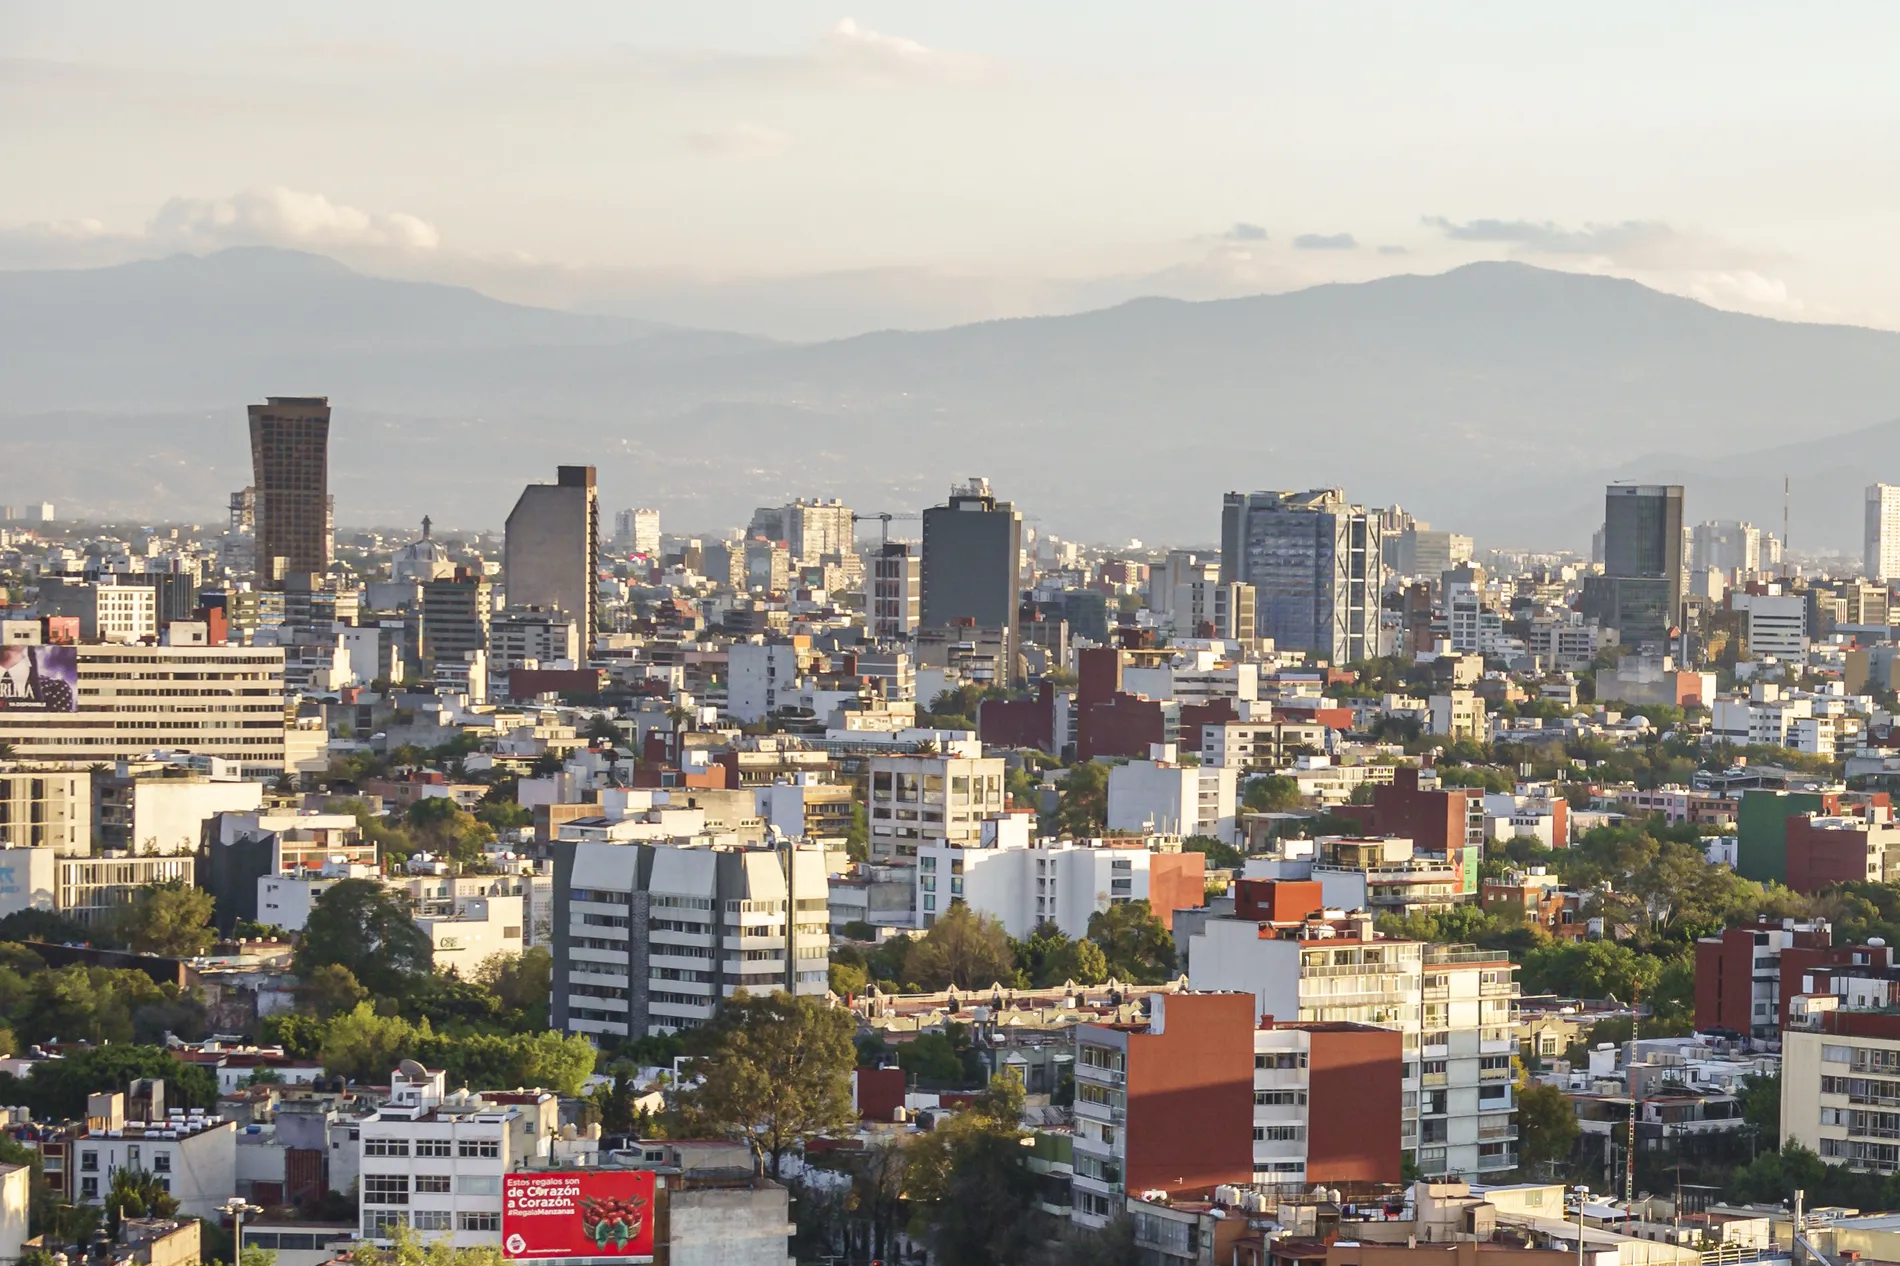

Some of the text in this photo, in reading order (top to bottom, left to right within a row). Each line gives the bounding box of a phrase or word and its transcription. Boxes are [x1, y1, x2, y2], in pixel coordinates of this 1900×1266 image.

[507, 1178, 530, 1187] Estos
[532, 1178, 563, 1187] regalos
[507, 1187, 524, 1197] de
[507, 1196, 575, 1208] a Corazón.
[507, 1208, 575, 1217] #RegalaManzanas
